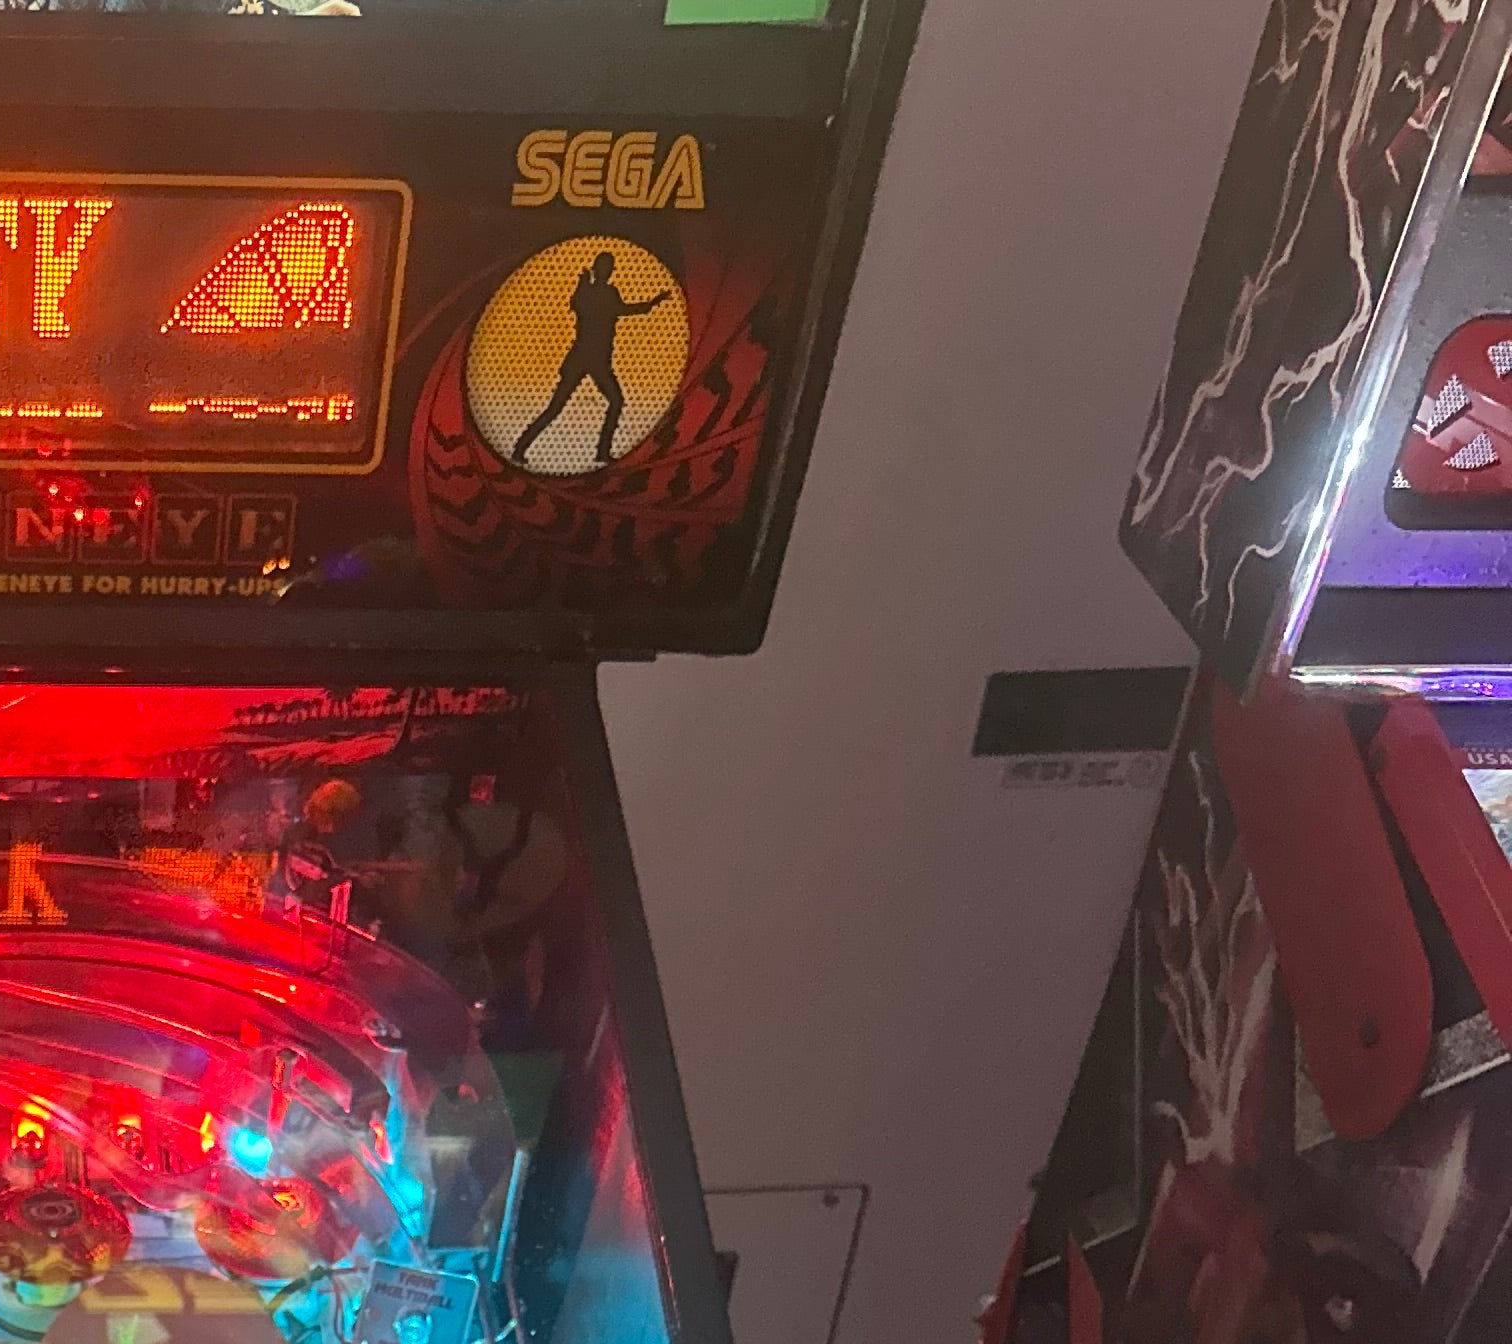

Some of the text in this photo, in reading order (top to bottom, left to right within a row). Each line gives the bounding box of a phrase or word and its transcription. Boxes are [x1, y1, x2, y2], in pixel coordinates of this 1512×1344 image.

[511, 130, 705, 209] SEGA
[83, 575, 130, 593] FOR
[141, 575, 288, 597] HURRY-UPS
